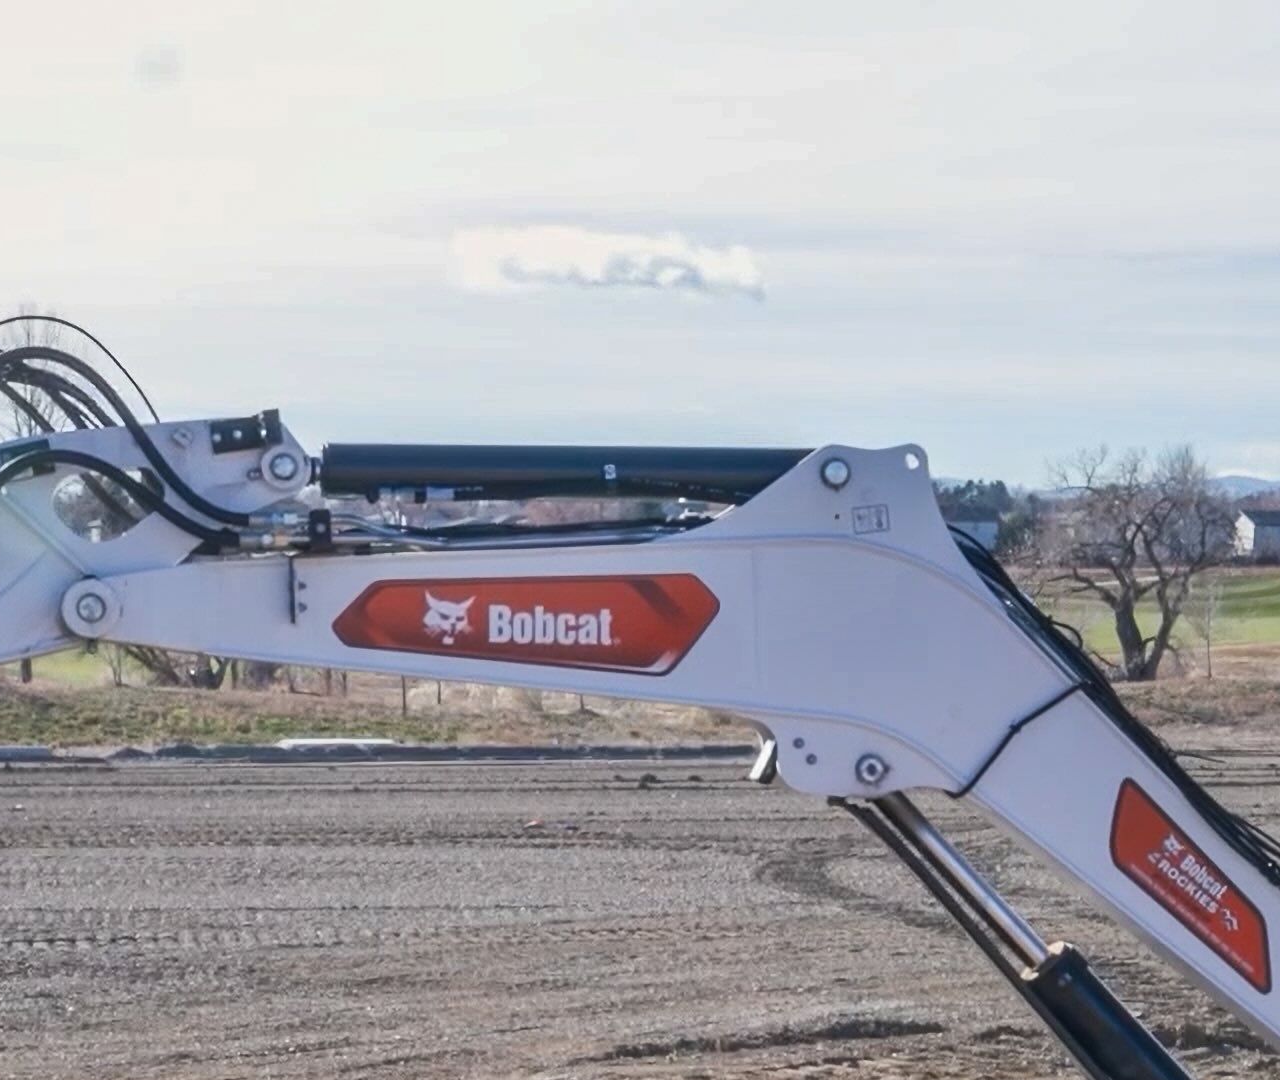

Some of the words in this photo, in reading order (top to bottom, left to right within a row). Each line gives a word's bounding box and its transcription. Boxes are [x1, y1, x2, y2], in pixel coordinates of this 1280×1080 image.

[488, 604, 613, 646] Bobcat
[1157, 858, 1219, 914] ROCKIES
[1180, 854, 1227, 898] Bobcat
